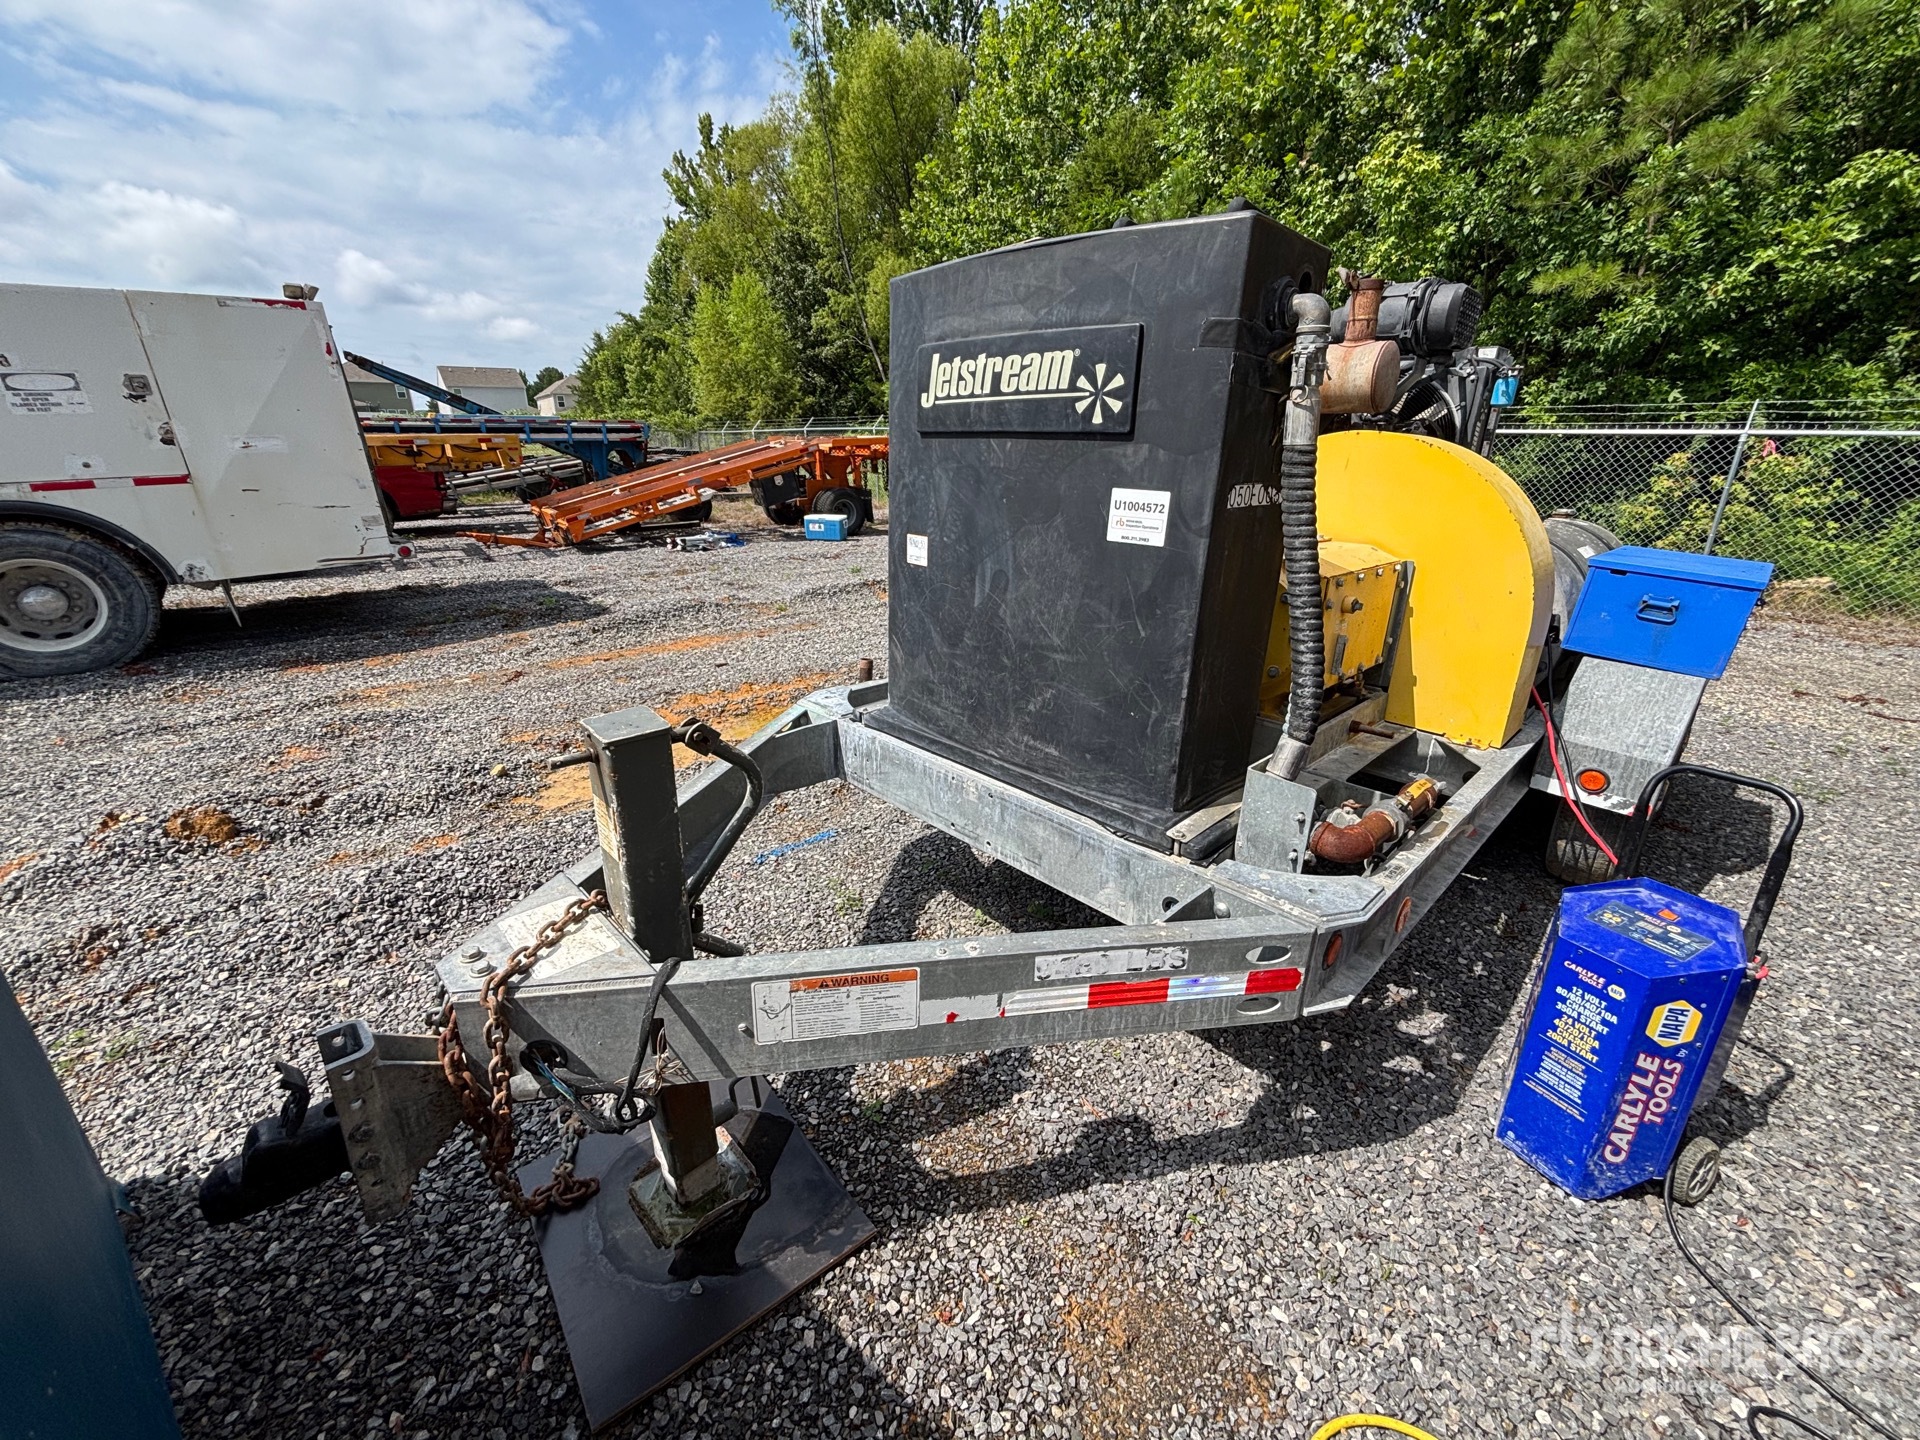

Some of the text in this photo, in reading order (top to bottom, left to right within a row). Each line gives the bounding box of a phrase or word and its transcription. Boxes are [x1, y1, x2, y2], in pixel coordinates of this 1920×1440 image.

[921, 350, 1074, 408] Jetstream
[1114, 500, 1165, 514] U1004572
[831, 974, 889, 988] WARNING
[1563, 960, 1606, 985] CARLYLE
[1578, 973, 1604, 989] TOOLS
[1555, 985, 1618, 1024] 80/60/40/10A
[1566, 999, 1602, 1024] CHARGE
[1572, 986, 1608, 1009] 12 VOLT
[1555, 1001, 1610, 1035] 350A START
[1561, 1014, 1598, 1039] 24 VOLT
[1657, 1007, 1691, 1041] NAPA
[1546, 1029, 1569, 1047] 200A
[1569, 1043, 1599, 1064] START
[1553, 1018, 1600, 1049] 40/20/10A
[1556, 1027, 1592, 1052] CHARGE
[1643, 1048, 1689, 1123] TOOLS by
[1603, 1052, 1661, 1164] CARLYLE
